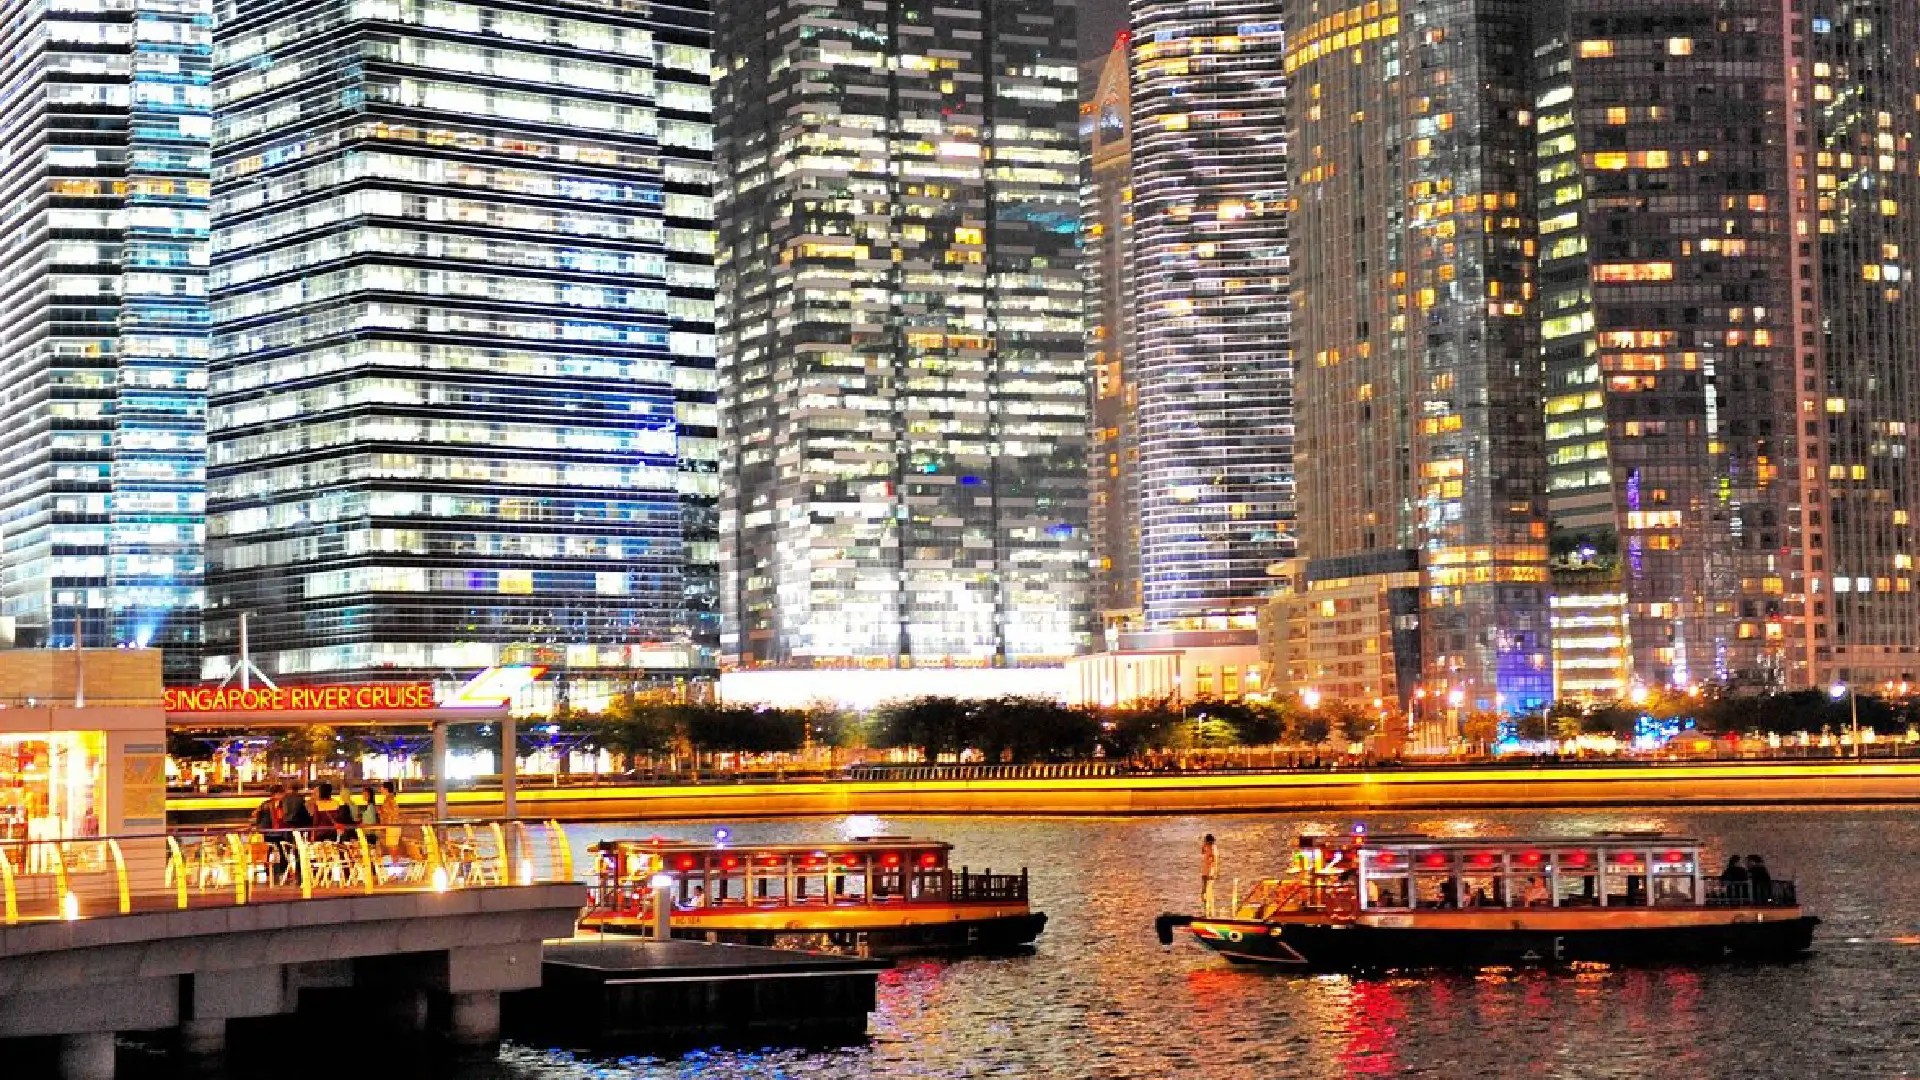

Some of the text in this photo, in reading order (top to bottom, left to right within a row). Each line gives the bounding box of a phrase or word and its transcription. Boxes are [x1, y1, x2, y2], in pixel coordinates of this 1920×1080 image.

[164, 686, 430, 710] SINGAPORE RIVER CRUISE
